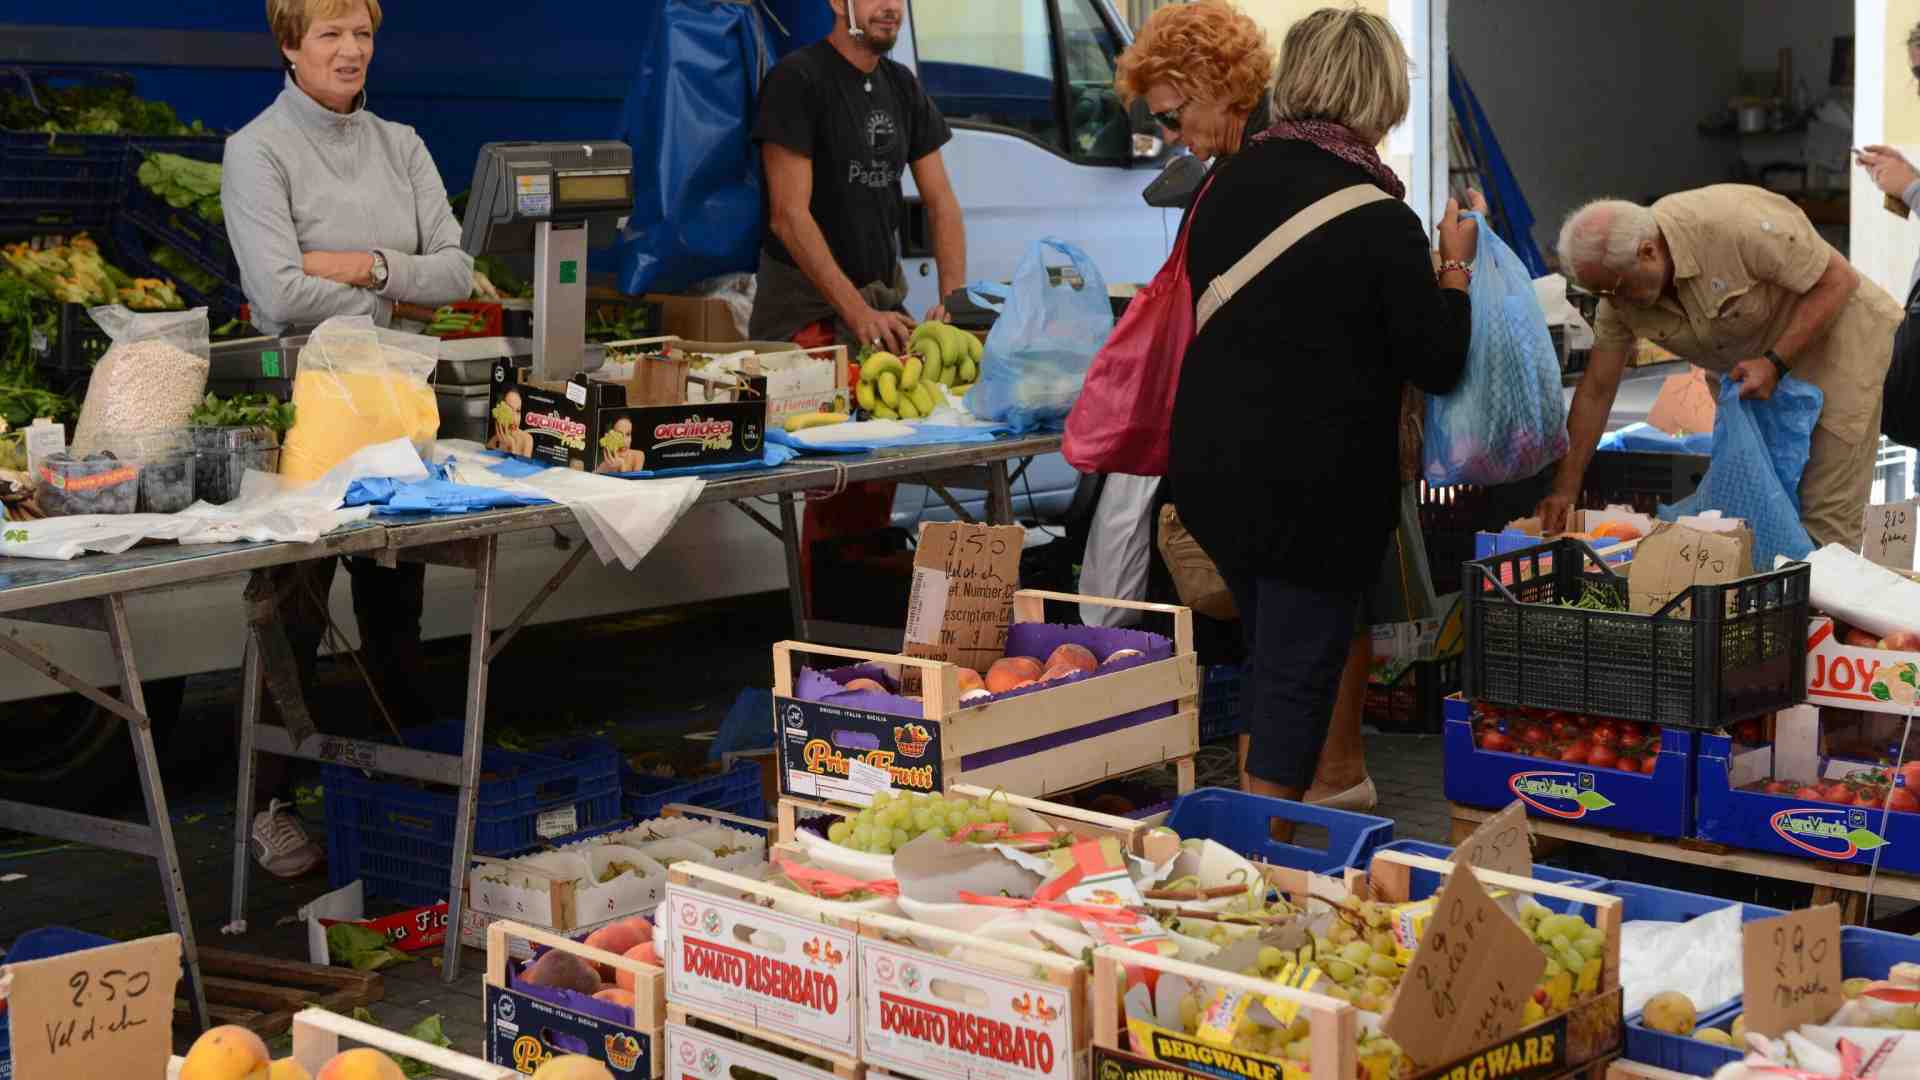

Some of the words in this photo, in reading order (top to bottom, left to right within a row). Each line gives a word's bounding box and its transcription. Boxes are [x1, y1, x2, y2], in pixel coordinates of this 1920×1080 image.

[525, 411, 586, 437] orchidea
[654, 417, 733, 439] orchidea
[1810, 654, 1881, 693] JOY
[683, 942, 744, 988] DONATO
[744, 952, 839, 1016] RISERBATO
[879, 1000, 945, 1046] DONATO
[947, 1008, 1055, 1074] RISERBATO
[1440, 1033, 1556, 1080] RGWARE
[1158, 1038, 1278, 1080] BERGWARE
